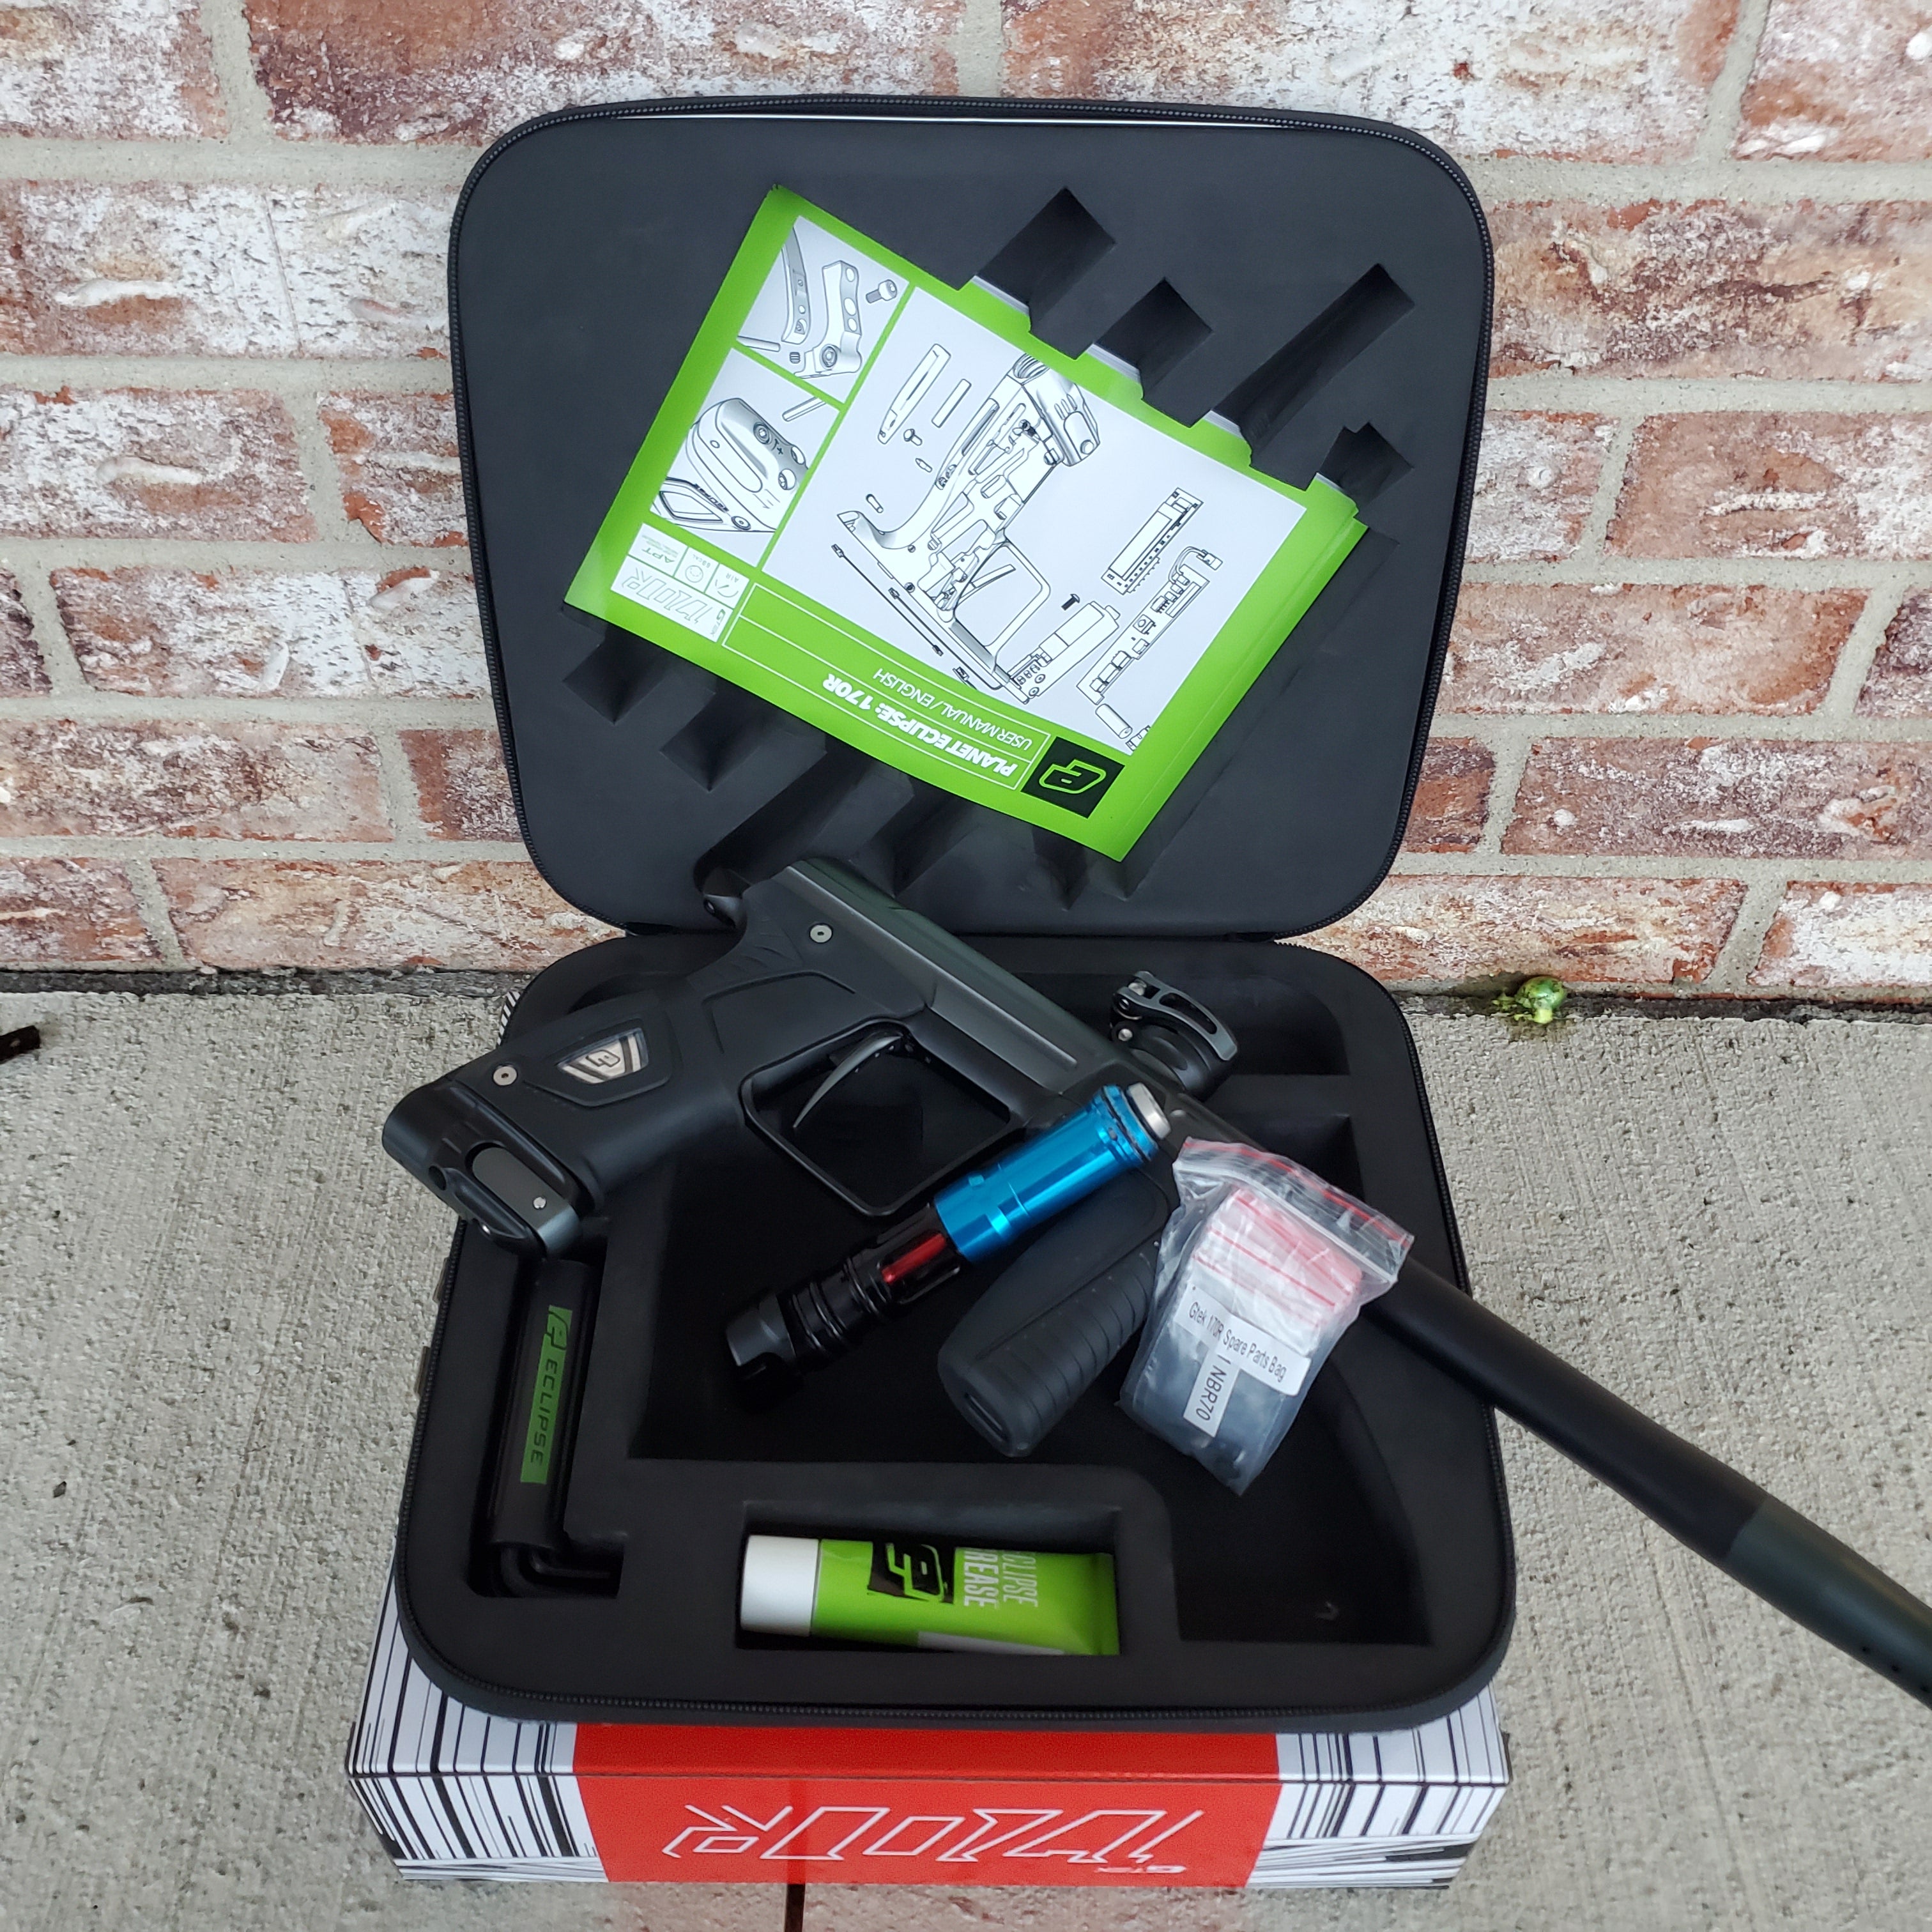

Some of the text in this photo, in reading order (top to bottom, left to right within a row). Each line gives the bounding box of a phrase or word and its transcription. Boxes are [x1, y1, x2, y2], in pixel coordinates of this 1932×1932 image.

[641, 547, 675, 564] APT
[725, 572, 739, 583] AIR
[622, 567, 713, 624] 170R
[872, 668, 935, 708] ENGLISH
[822, 673, 1019, 778] PLANET ECLIPSE: 170R
[940, 702, 1000, 739] MANUAL
[996, 728, 1033, 751] USER
[1189, 1301, 1287, 1383] Gtek 170R Spare Parts Bag
[530, 1358, 558, 1465] ECLIPSE
[1195, 1365, 1227, 1422] NBR70
[963, 1549, 1000, 1609] REASE
[1002, 1552, 1039, 1608] CLIPSE
[662, 1804, 1204, 1864] 170R
